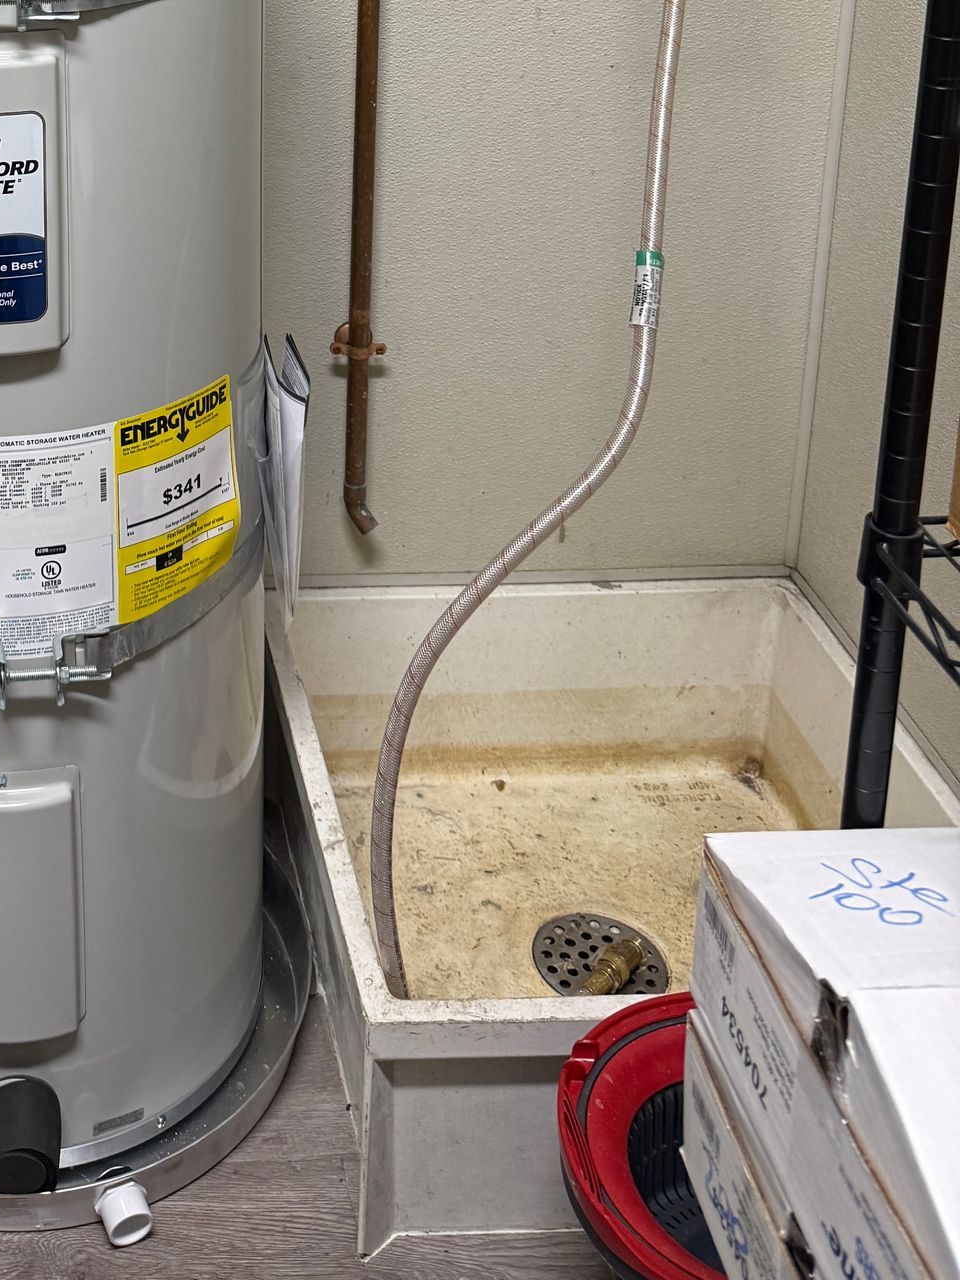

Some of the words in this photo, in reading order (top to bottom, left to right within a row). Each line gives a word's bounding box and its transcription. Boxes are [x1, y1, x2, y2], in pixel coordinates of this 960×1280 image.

[11, 260, 38, 271] Best
[121, 384, 226, 446] ENERGYGUIDE
[26, 437, 57, 445] STORAGE
[58, 434, 80, 442] WATER
[82, 429, 106, 439] HEATER
[154, 461, 174, 473] Estimated
[174, 458, 185, 466] Yearly
[185, 452, 197, 462] Energy
[163, 473, 200, 505] $341
[45, 565, 56, 575] UL
[820, 857, 957, 917] Ste
[808, 883, 923, 926] 100
